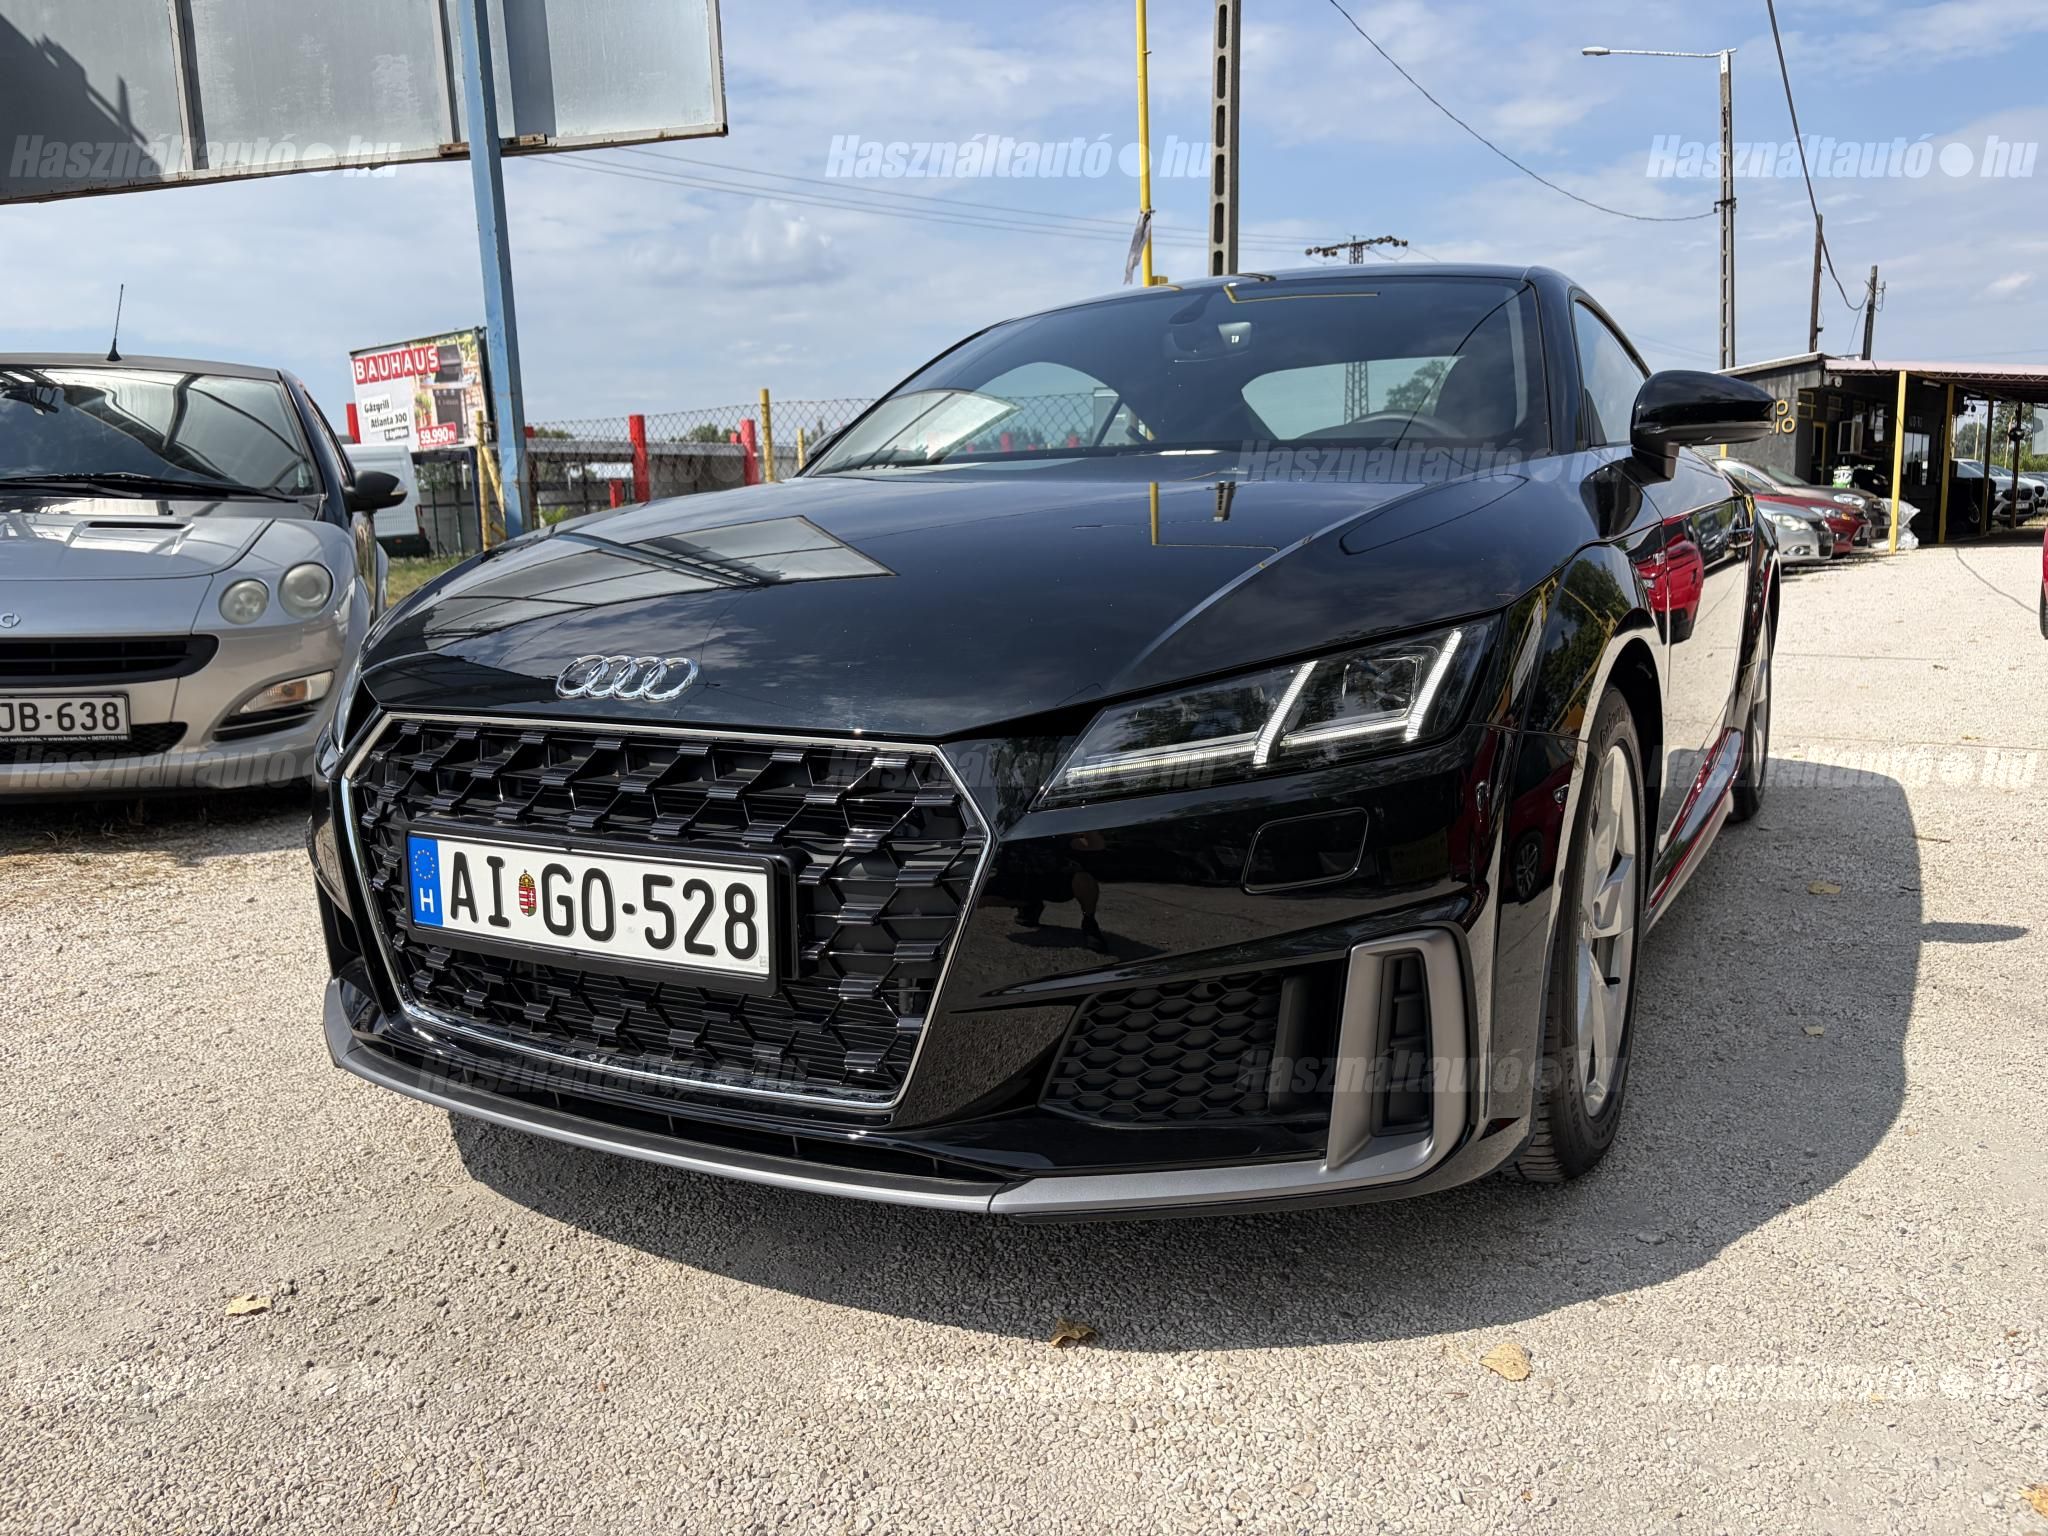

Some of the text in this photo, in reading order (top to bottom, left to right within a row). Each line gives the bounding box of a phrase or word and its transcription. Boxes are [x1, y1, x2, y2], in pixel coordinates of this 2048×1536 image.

[356, 346, 439, 382] BAUHAUS
[364, 400, 389, 414] Gázgrill
[371, 412, 408, 428] Atlanta 300
[420, 427, 448, 444] 59.990
[0, 701, 120, 733] JB-638
[419, 887, 434, 913] H
[449, 851, 759, 960] AI GO-528
